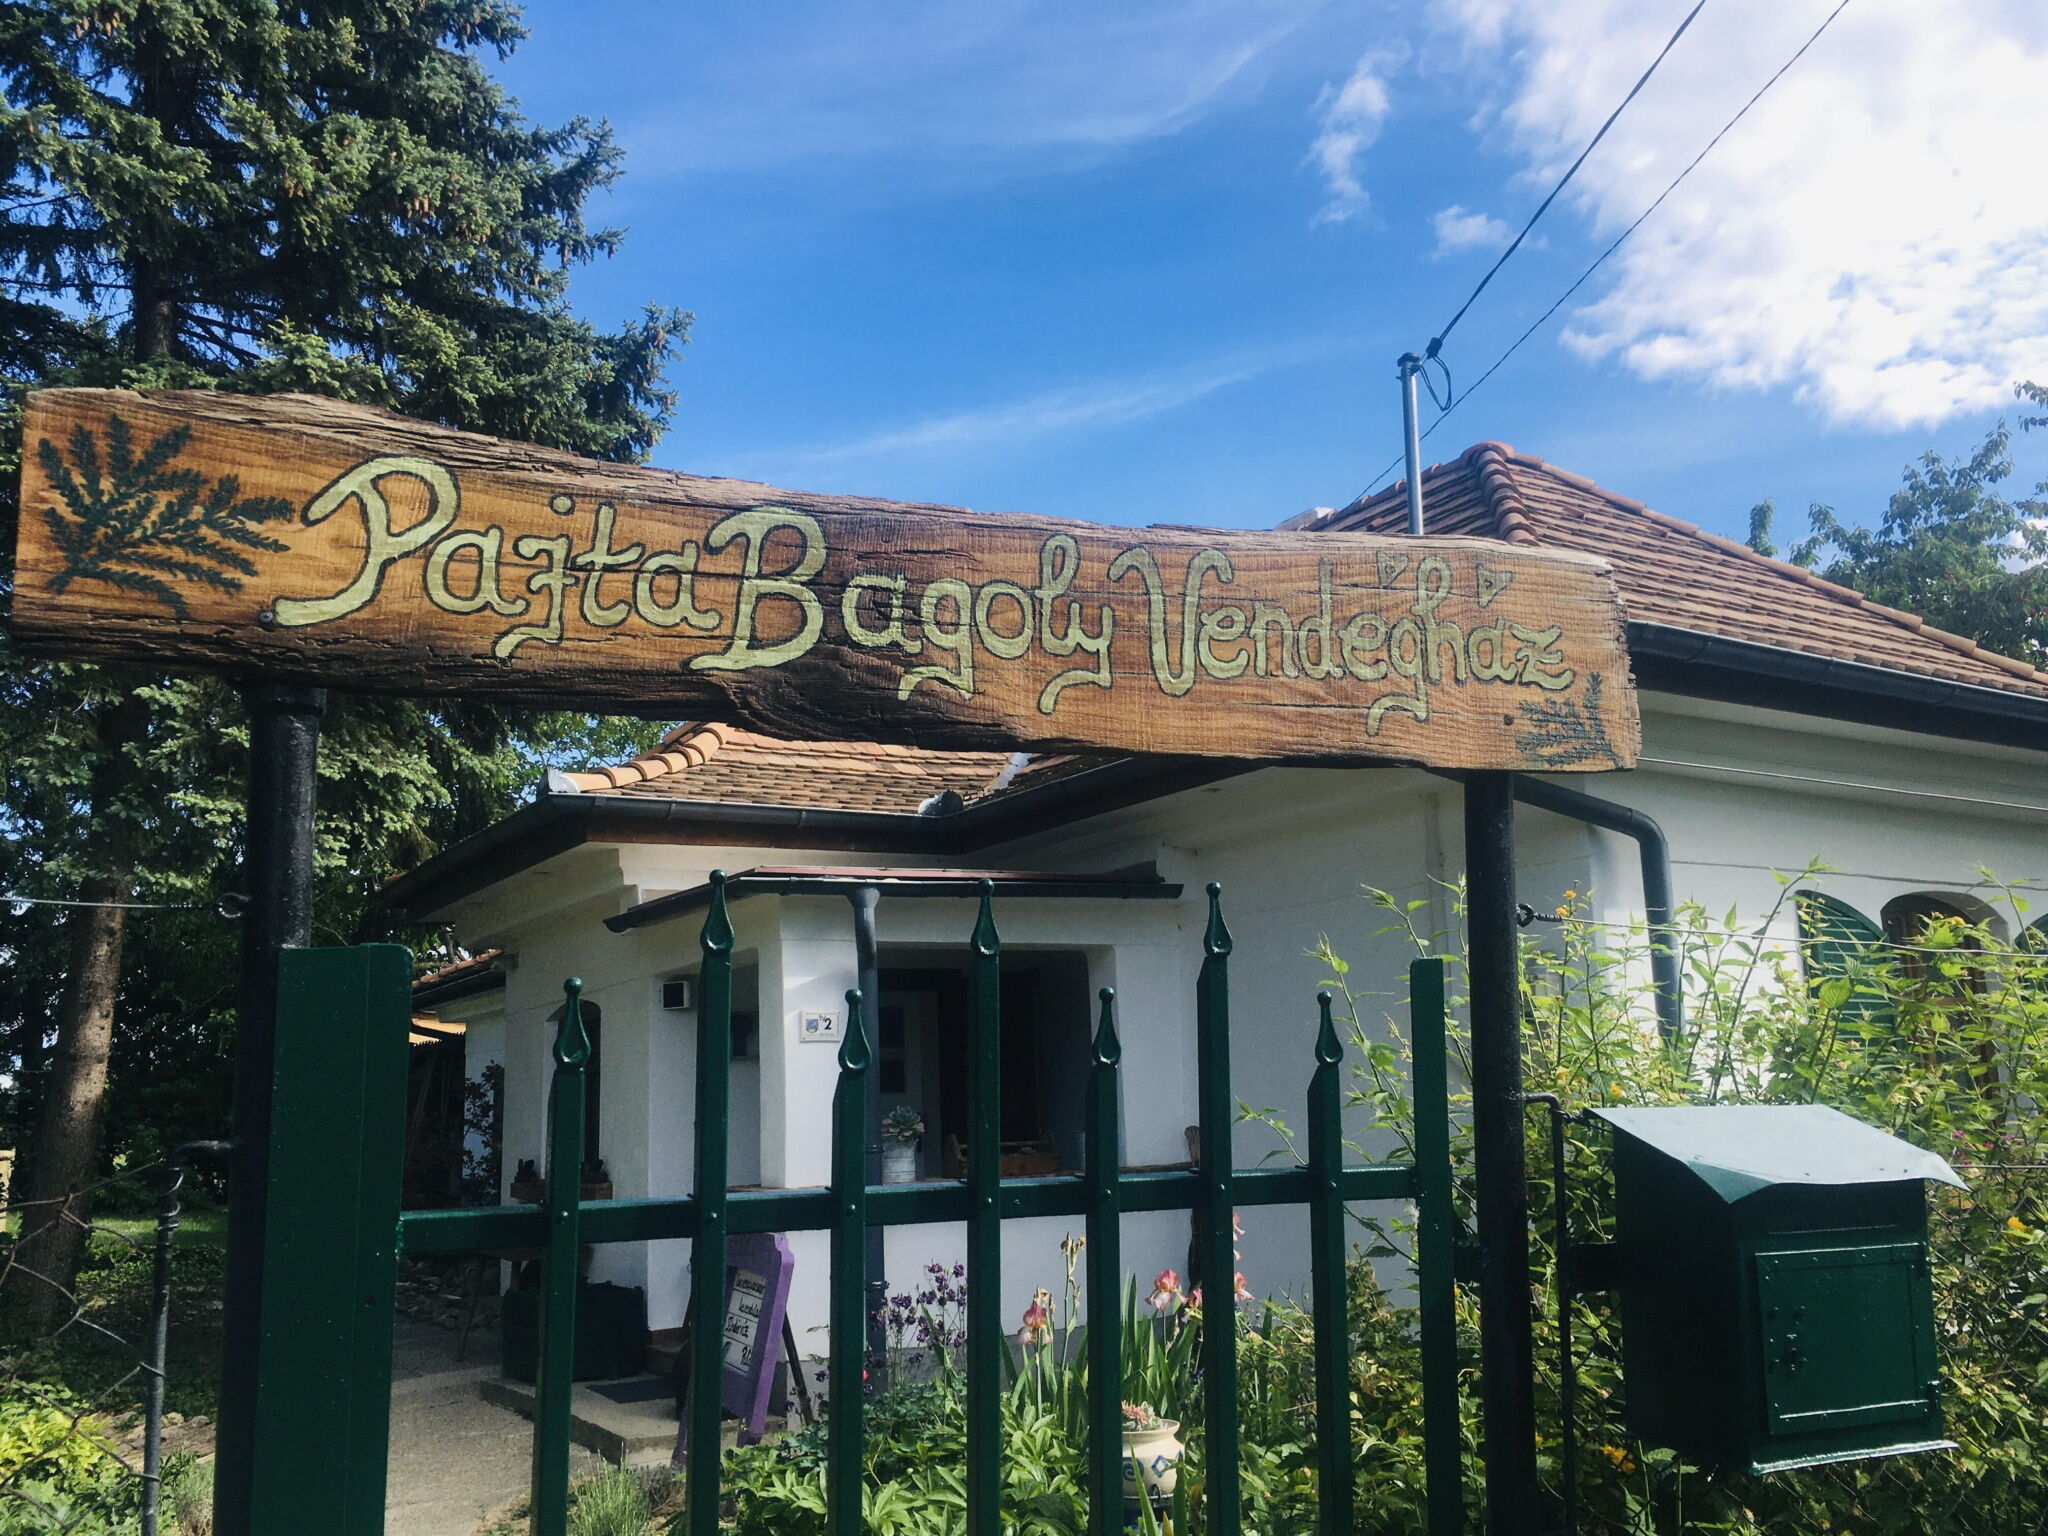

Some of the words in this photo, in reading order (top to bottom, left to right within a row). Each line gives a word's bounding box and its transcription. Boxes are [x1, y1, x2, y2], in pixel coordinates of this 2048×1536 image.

[273, 455, 722, 662] Pajta
[688, 506, 1113, 714] Bagoly
[824, 1017, 832, 1030] 2
